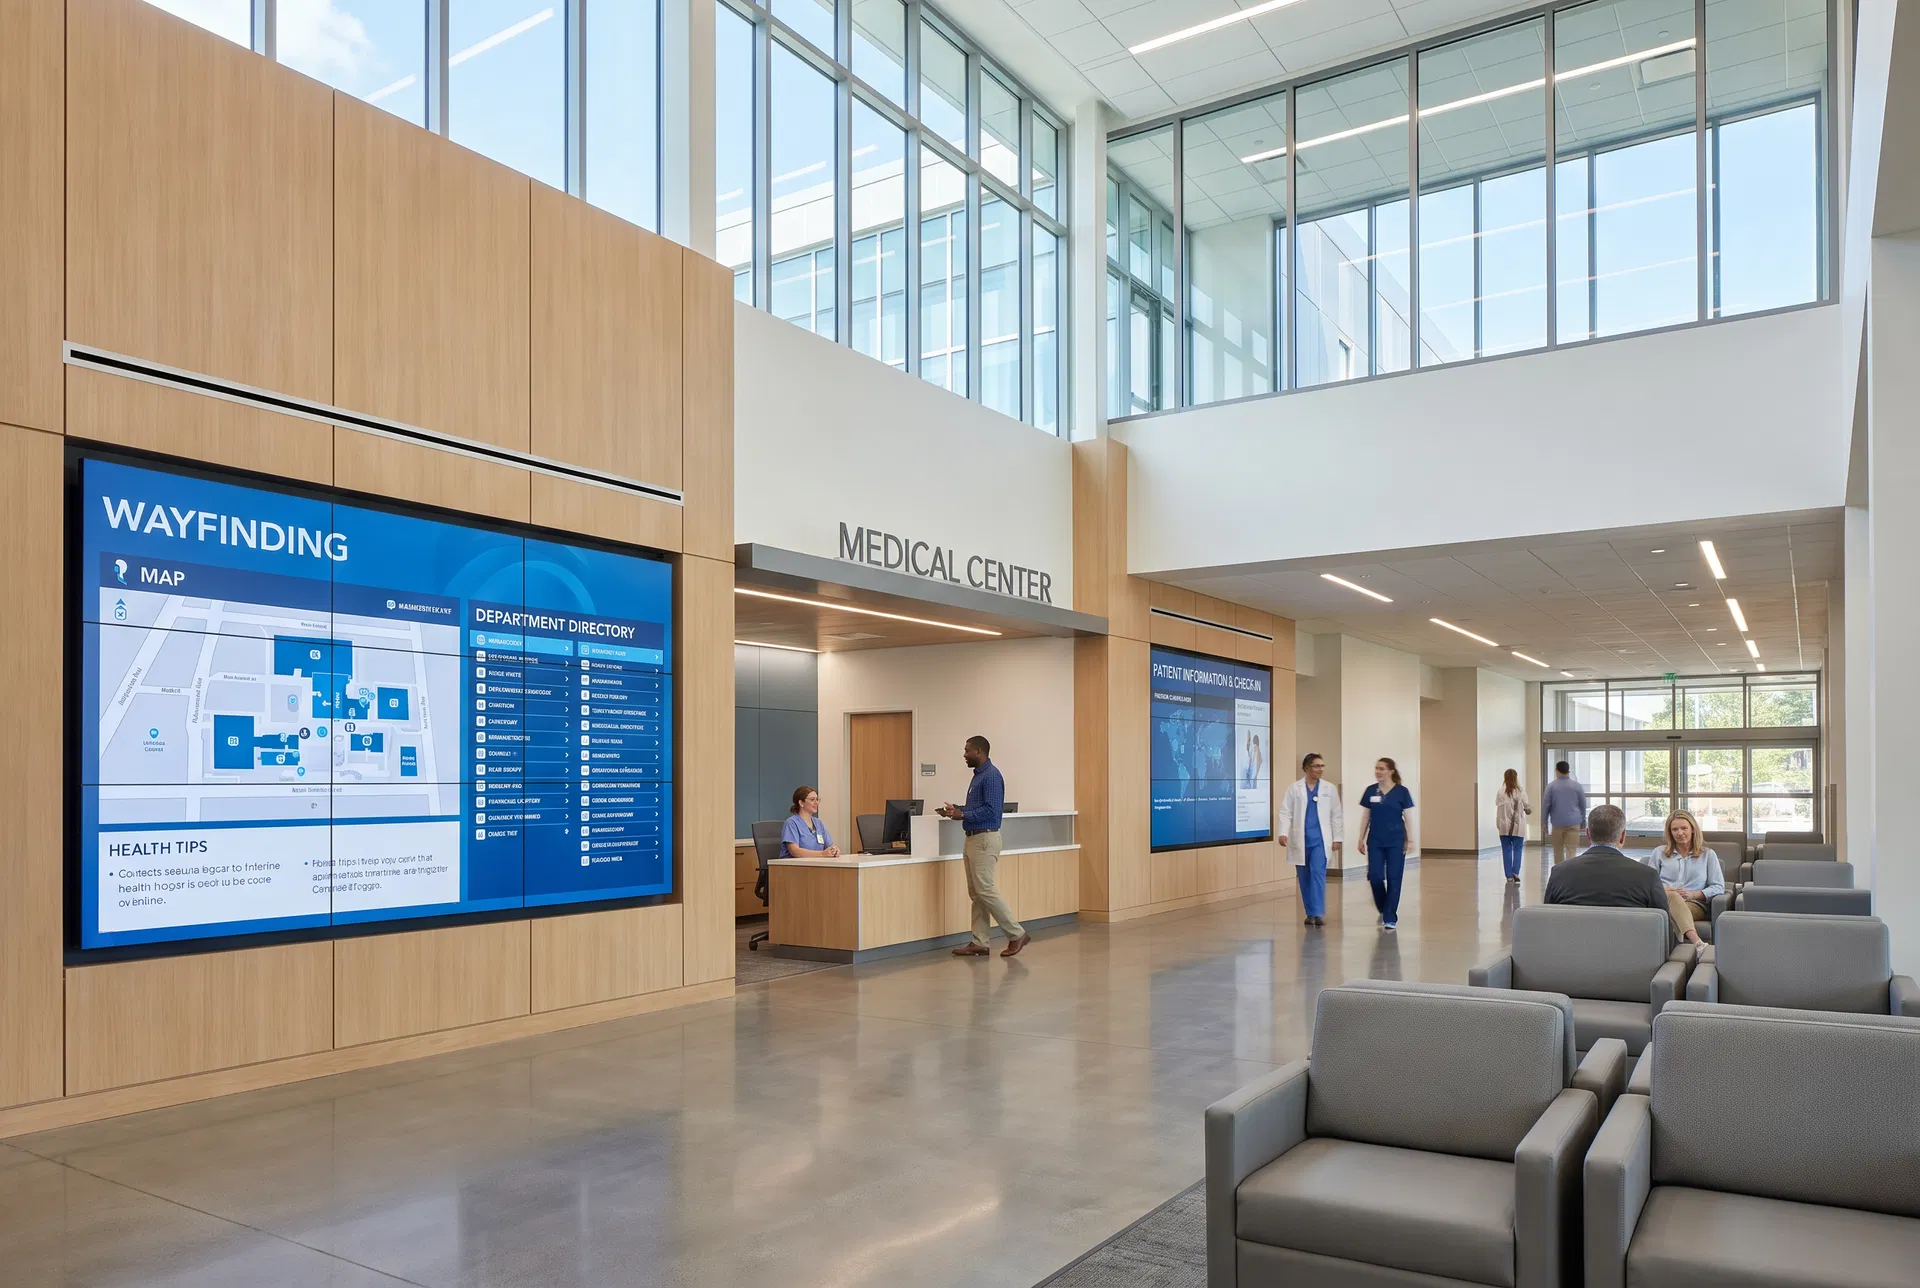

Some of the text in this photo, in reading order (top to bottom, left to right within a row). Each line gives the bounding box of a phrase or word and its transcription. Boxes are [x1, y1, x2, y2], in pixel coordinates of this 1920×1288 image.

[102, 496, 348, 562] WAYFINDING
[839, 521, 1053, 603] MEDICAL CENTER
[140, 566, 185, 587] MAP
[476, 608, 566, 632] DEPARTMENT
[569, 619, 636, 639] DIRECTORY
[1153, 663, 1182, 680] PATIENT
[1183, 668, 1228, 687] INFORMATION
[1228, 675, 1235, 688] &
[109, 840, 208, 857] HEALTH TIPS
[232, 864, 243, 873] to
[118, 882, 151, 893] health
[187, 880, 196, 889] is
[232, 876, 246, 886] be
